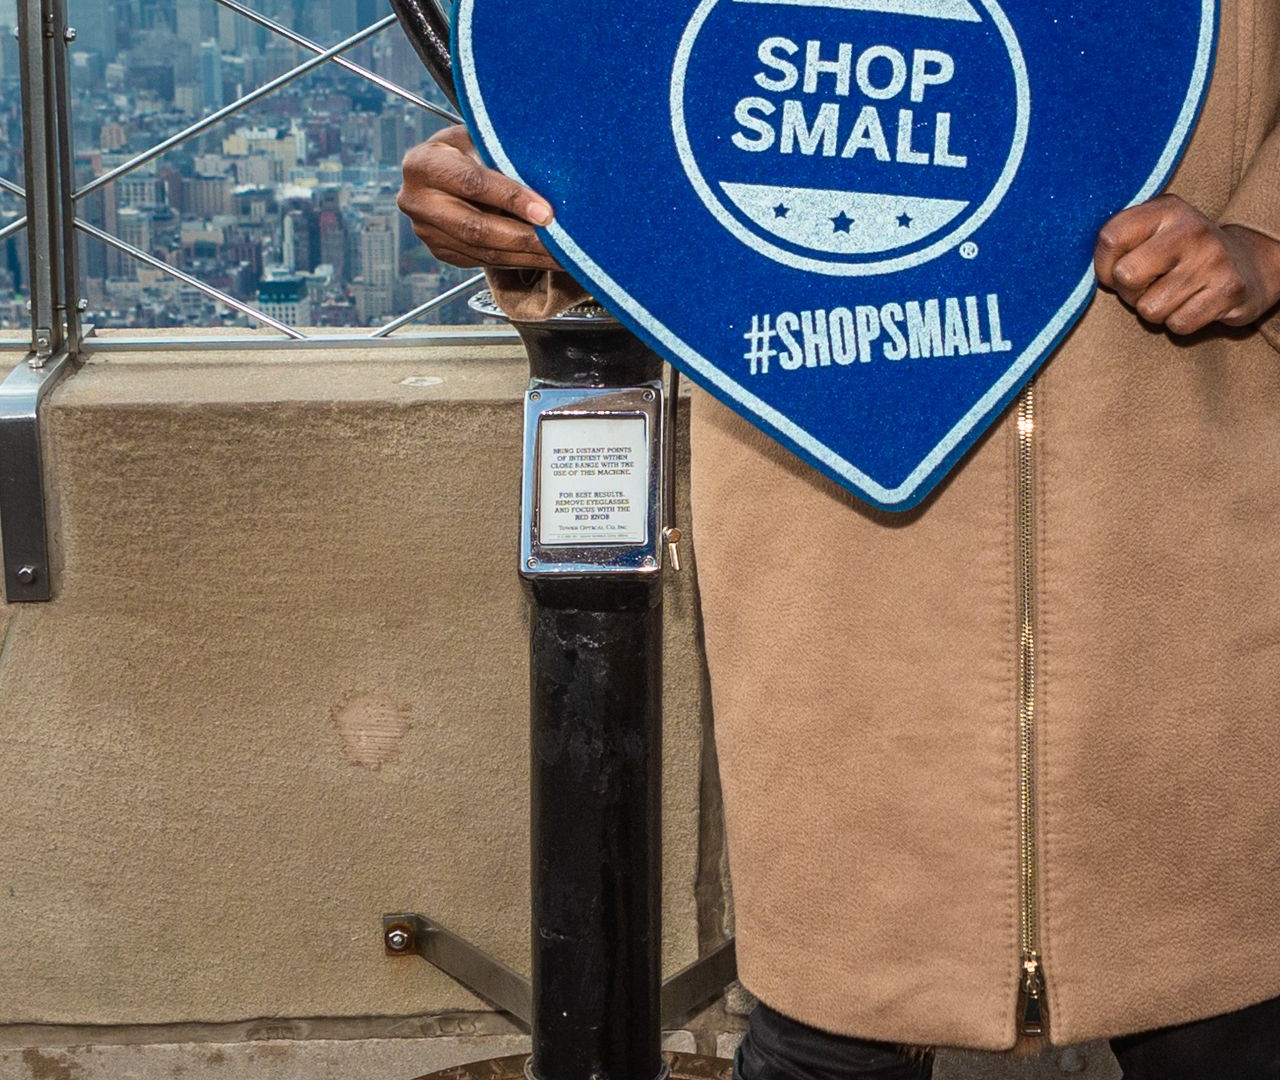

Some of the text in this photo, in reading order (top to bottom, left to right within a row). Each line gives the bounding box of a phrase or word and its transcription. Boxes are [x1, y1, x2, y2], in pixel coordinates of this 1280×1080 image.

[753, 36, 955, 103] SHOP
[731, 96, 968, 169] SMALL
[743, 293, 1012, 375] #SHOPSMALL
